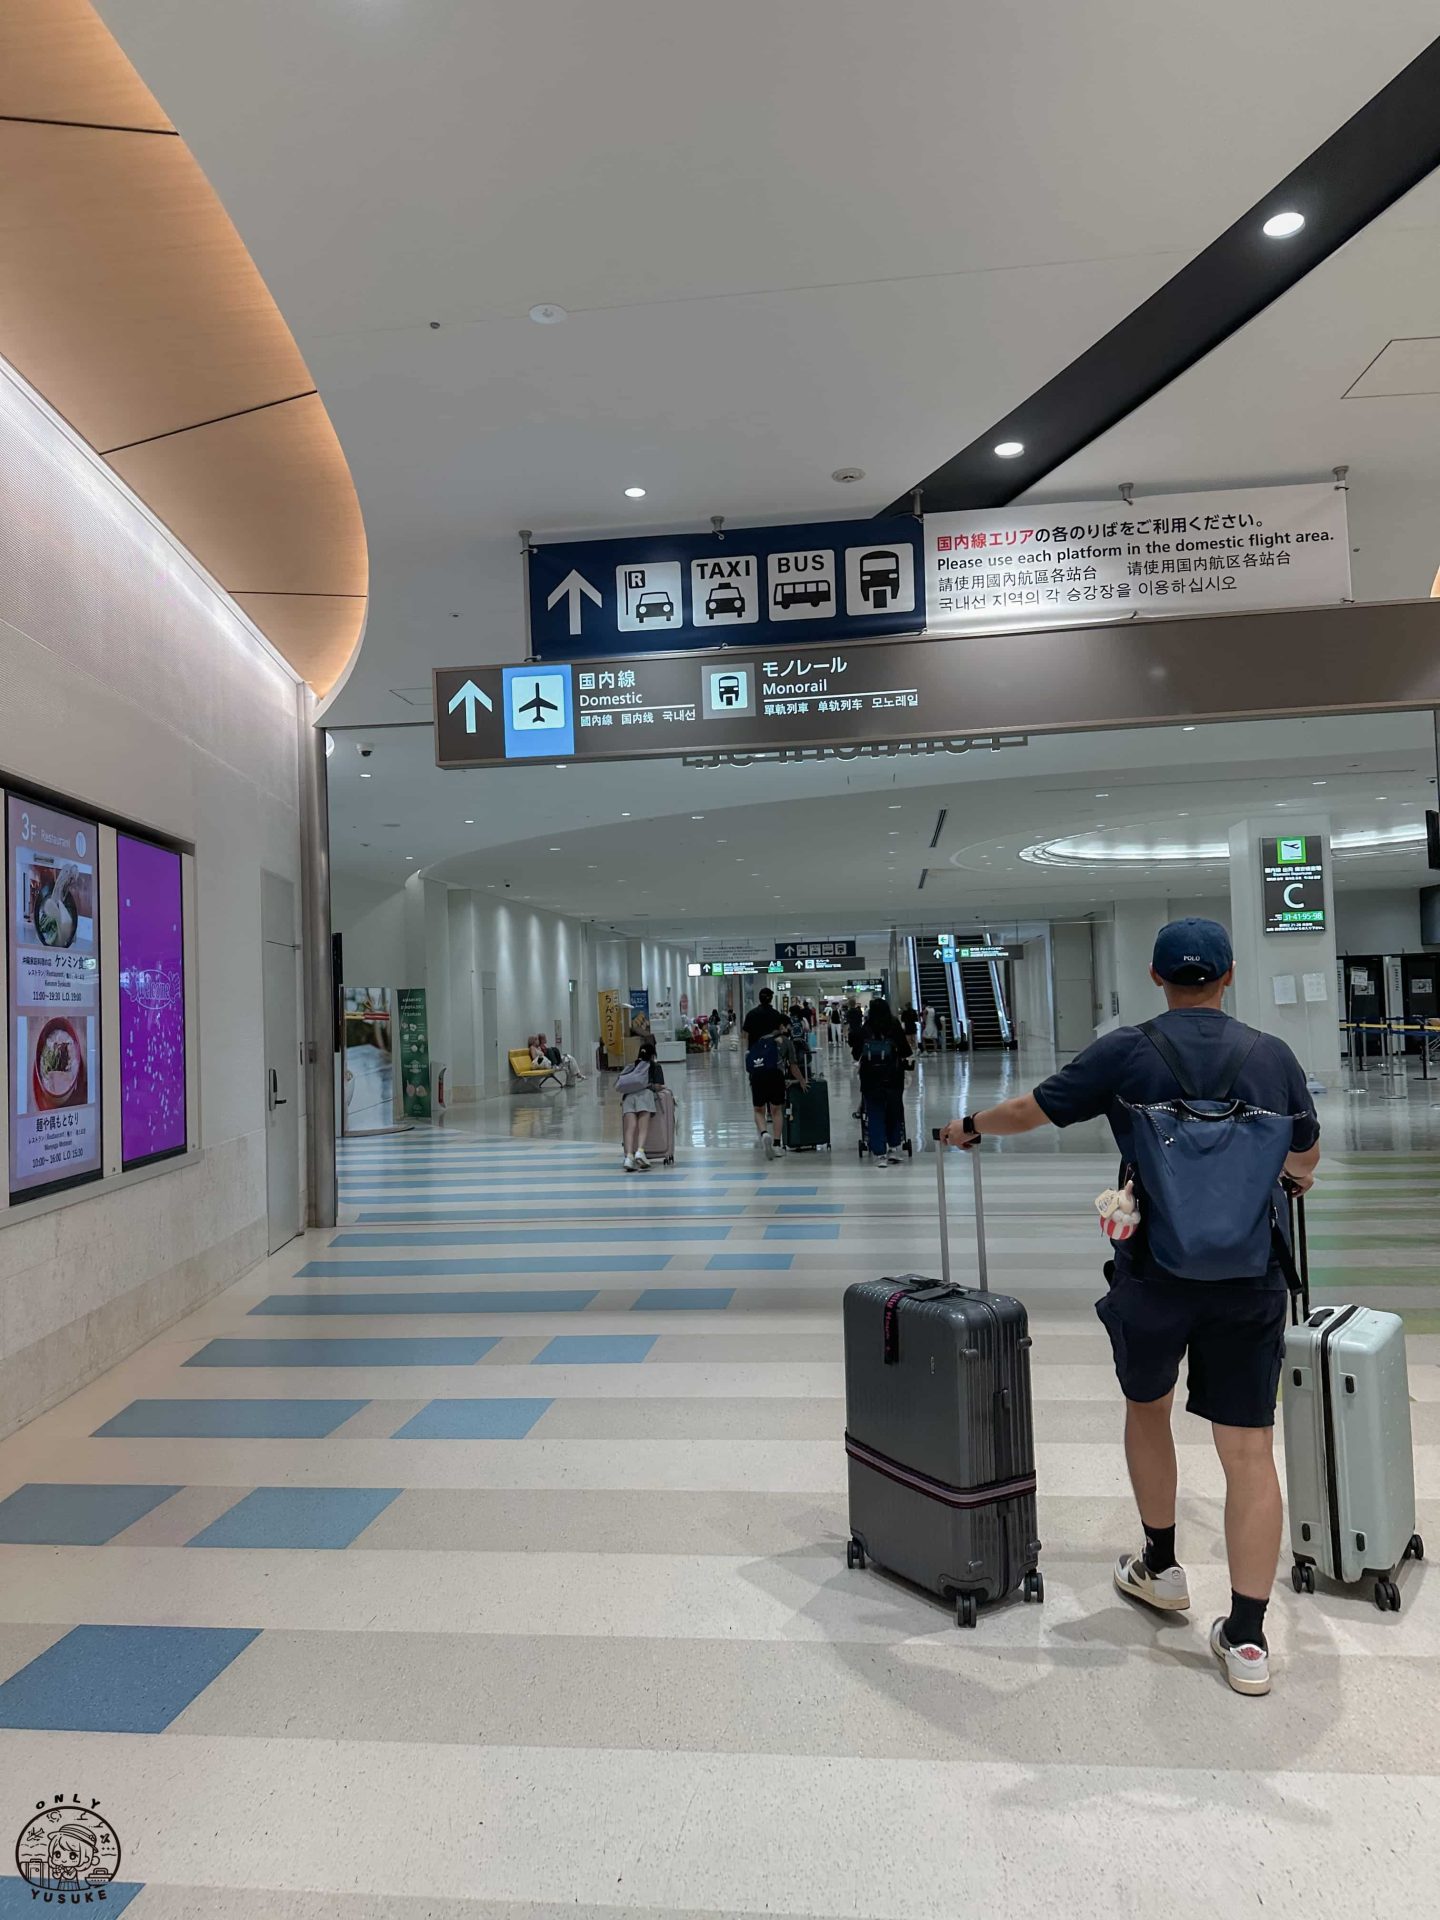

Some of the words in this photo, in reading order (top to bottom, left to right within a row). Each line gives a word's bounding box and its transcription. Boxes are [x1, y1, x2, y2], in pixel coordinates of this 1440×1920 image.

[937, 513, 1263, 551] 国内線エリアの各のりばをご利用ください。
[937, 557, 983, 571] Please
[988, 557, 1013, 567] use
[1017, 550, 1051, 564] each
[1057, 544, 1122, 563] platform
[1127, 543, 1140, 555] in
[1146, 541, 1171, 554] the
[1176, 535, 1244, 552] domestic
[1249, 532, 1291, 549] flight
[1295, 531, 1334, 543] area.
[697, 559, 750, 580] TAXI
[777, 554, 825, 574] BUS
[1127, 550, 1291, 576] 请使用国内航区各站台
[630, 572, 644, 588] R
[939, 594, 986, 612] 국내선
[992, 590, 1040, 607] 지역의
[1046, 588, 1061, 603] 각
[1067, 582, 1132, 602] 승강장을
[1138, 575, 1238, 597] 이용하십시오
[762, 656, 848, 678] モノレール
[579, 669, 636, 690] 国内線
[763, 678, 827, 696] Monorail
[579, 691, 643, 707] Domestic
[764, 702, 809, 716] 單軌列車
[817, 698, 863, 713] 单轨列车
[871, 693, 919, 709] 모노레일
[621, 711, 654, 725] 国内线
[662, 708, 696, 722] 국내선
[1283, 883, 1305, 909] C
[55, 954, 90, 970] ケンミン食
